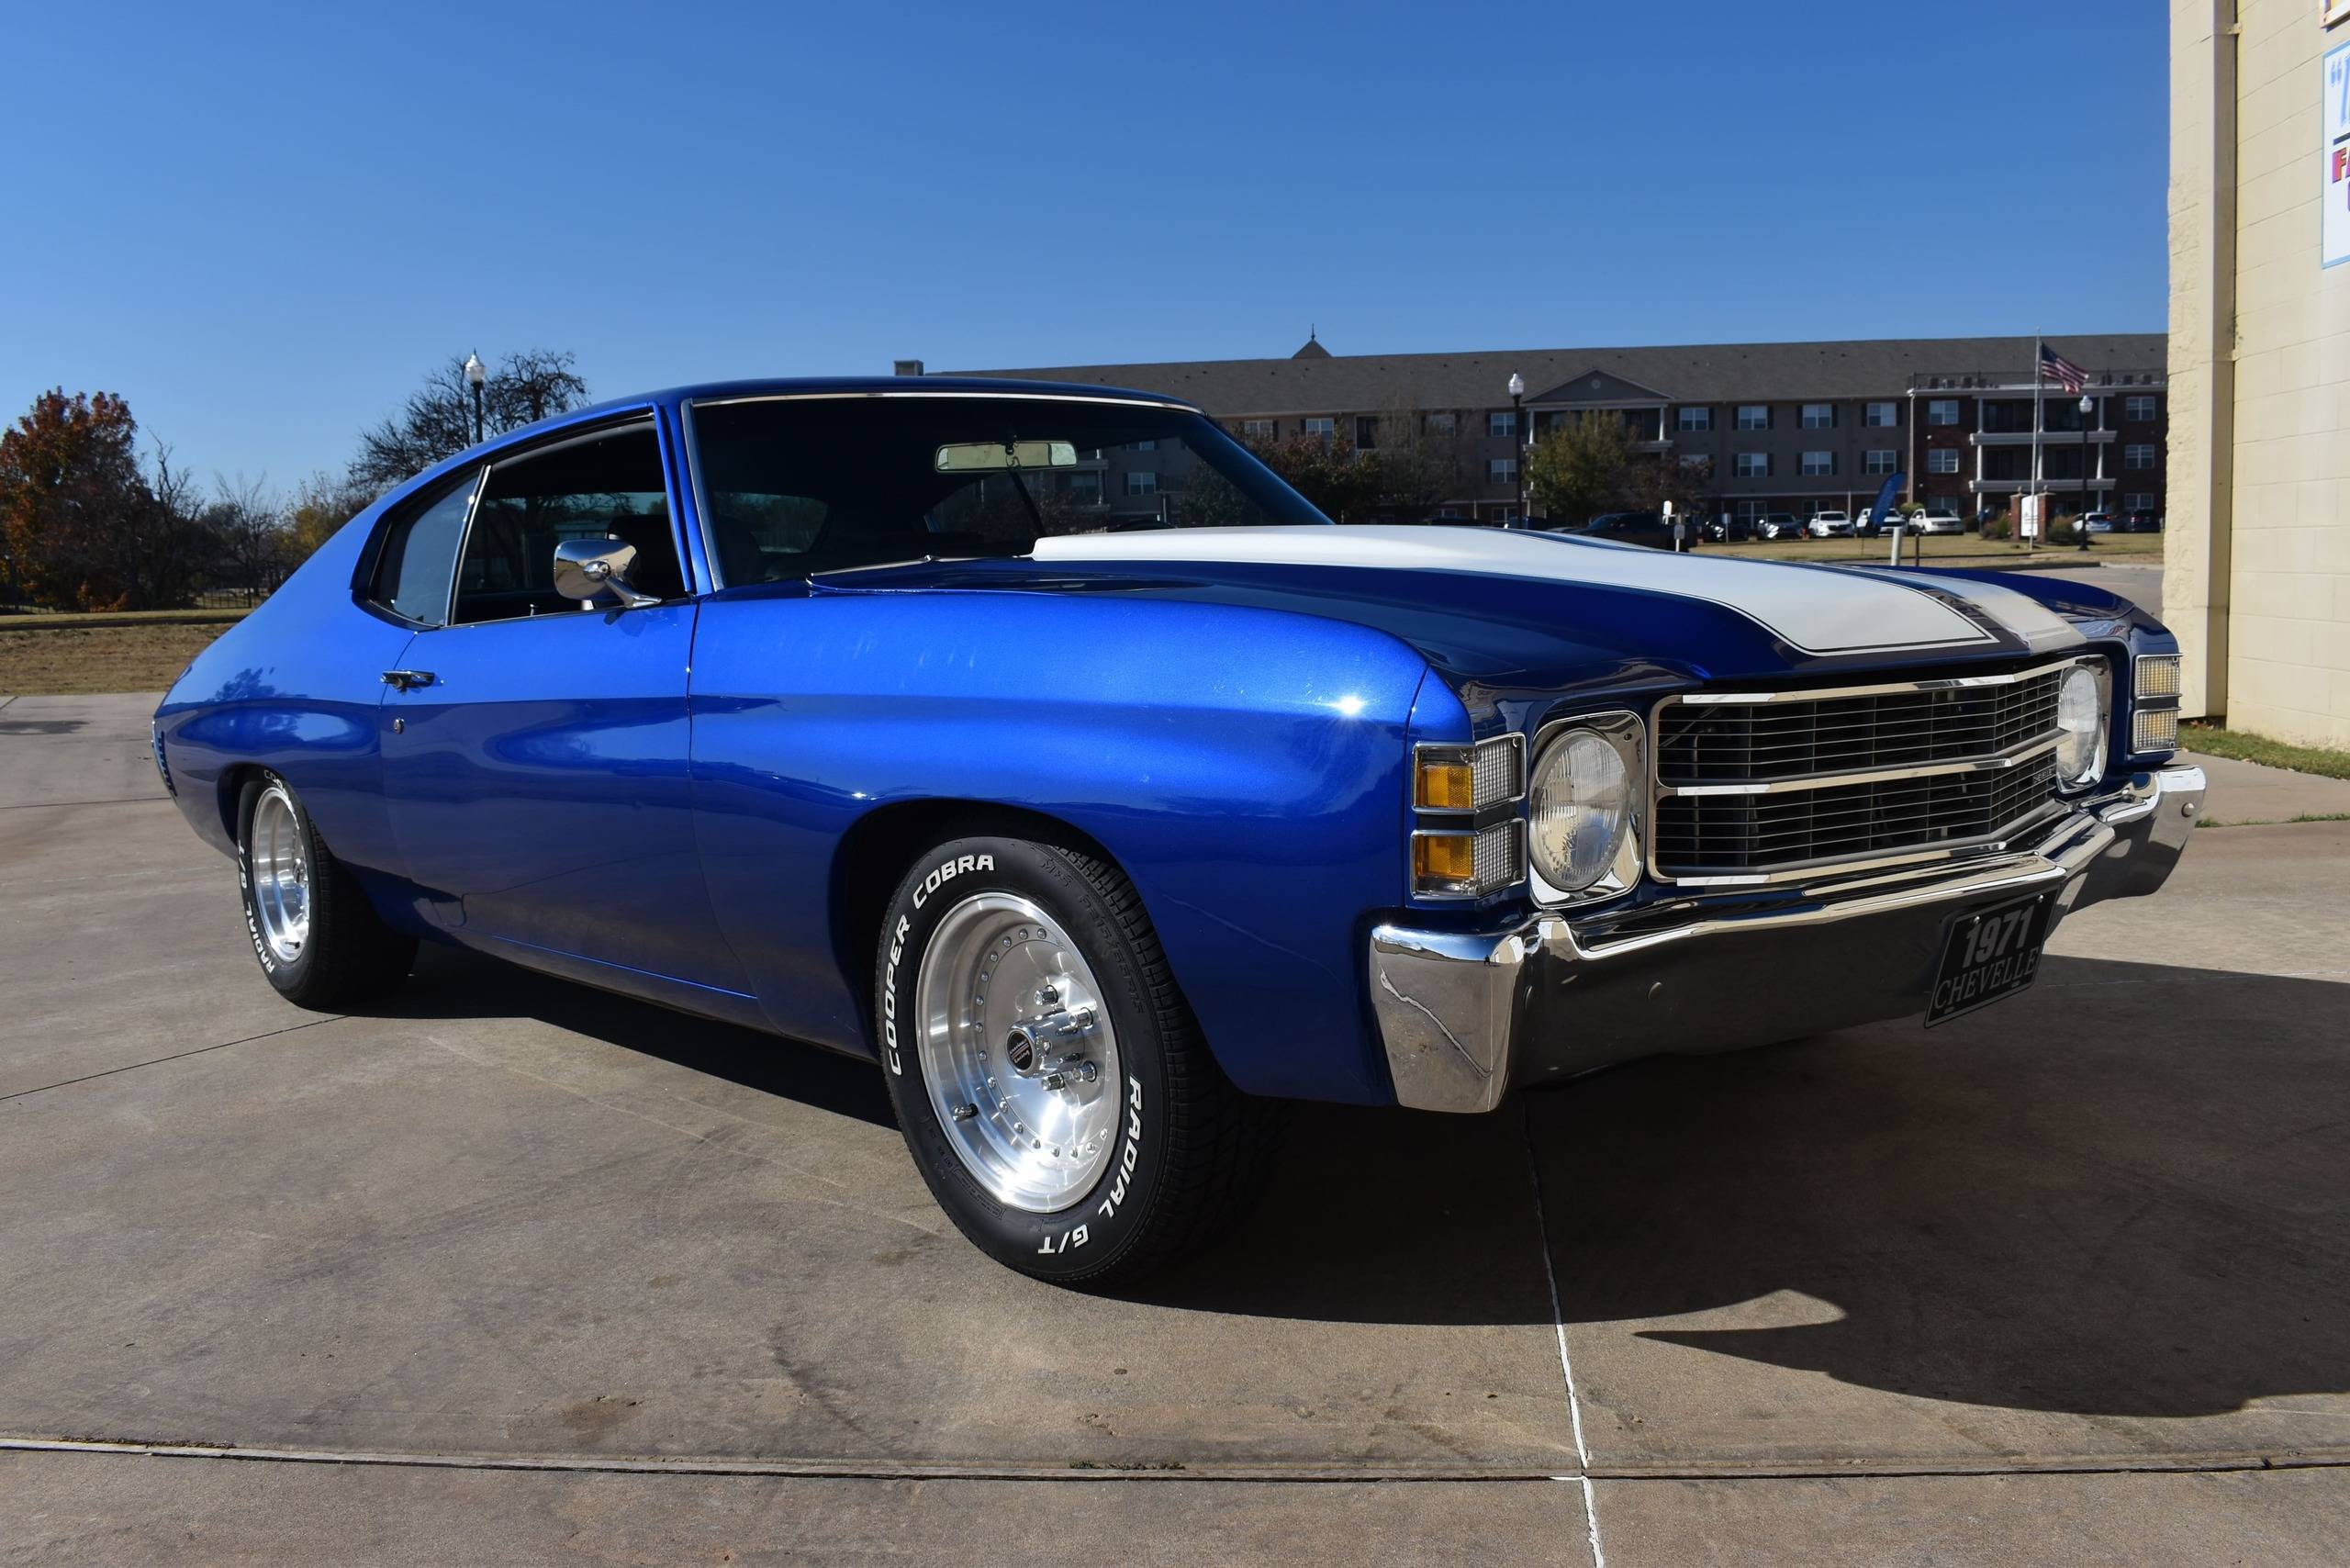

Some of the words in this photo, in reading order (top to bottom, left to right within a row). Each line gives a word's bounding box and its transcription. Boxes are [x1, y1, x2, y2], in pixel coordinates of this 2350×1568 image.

[246, 902, 275, 974] RADIAL
[884, 913, 912, 1077] COOPER
[912, 854, 995, 910] COBRA
[1962, 905, 2035, 969] 1971
[1933, 946, 2040, 1009] CHEVELLE
[1098, 1075, 1143, 1219] RADIAL
[1037, 1224, 1090, 1255] G/T
